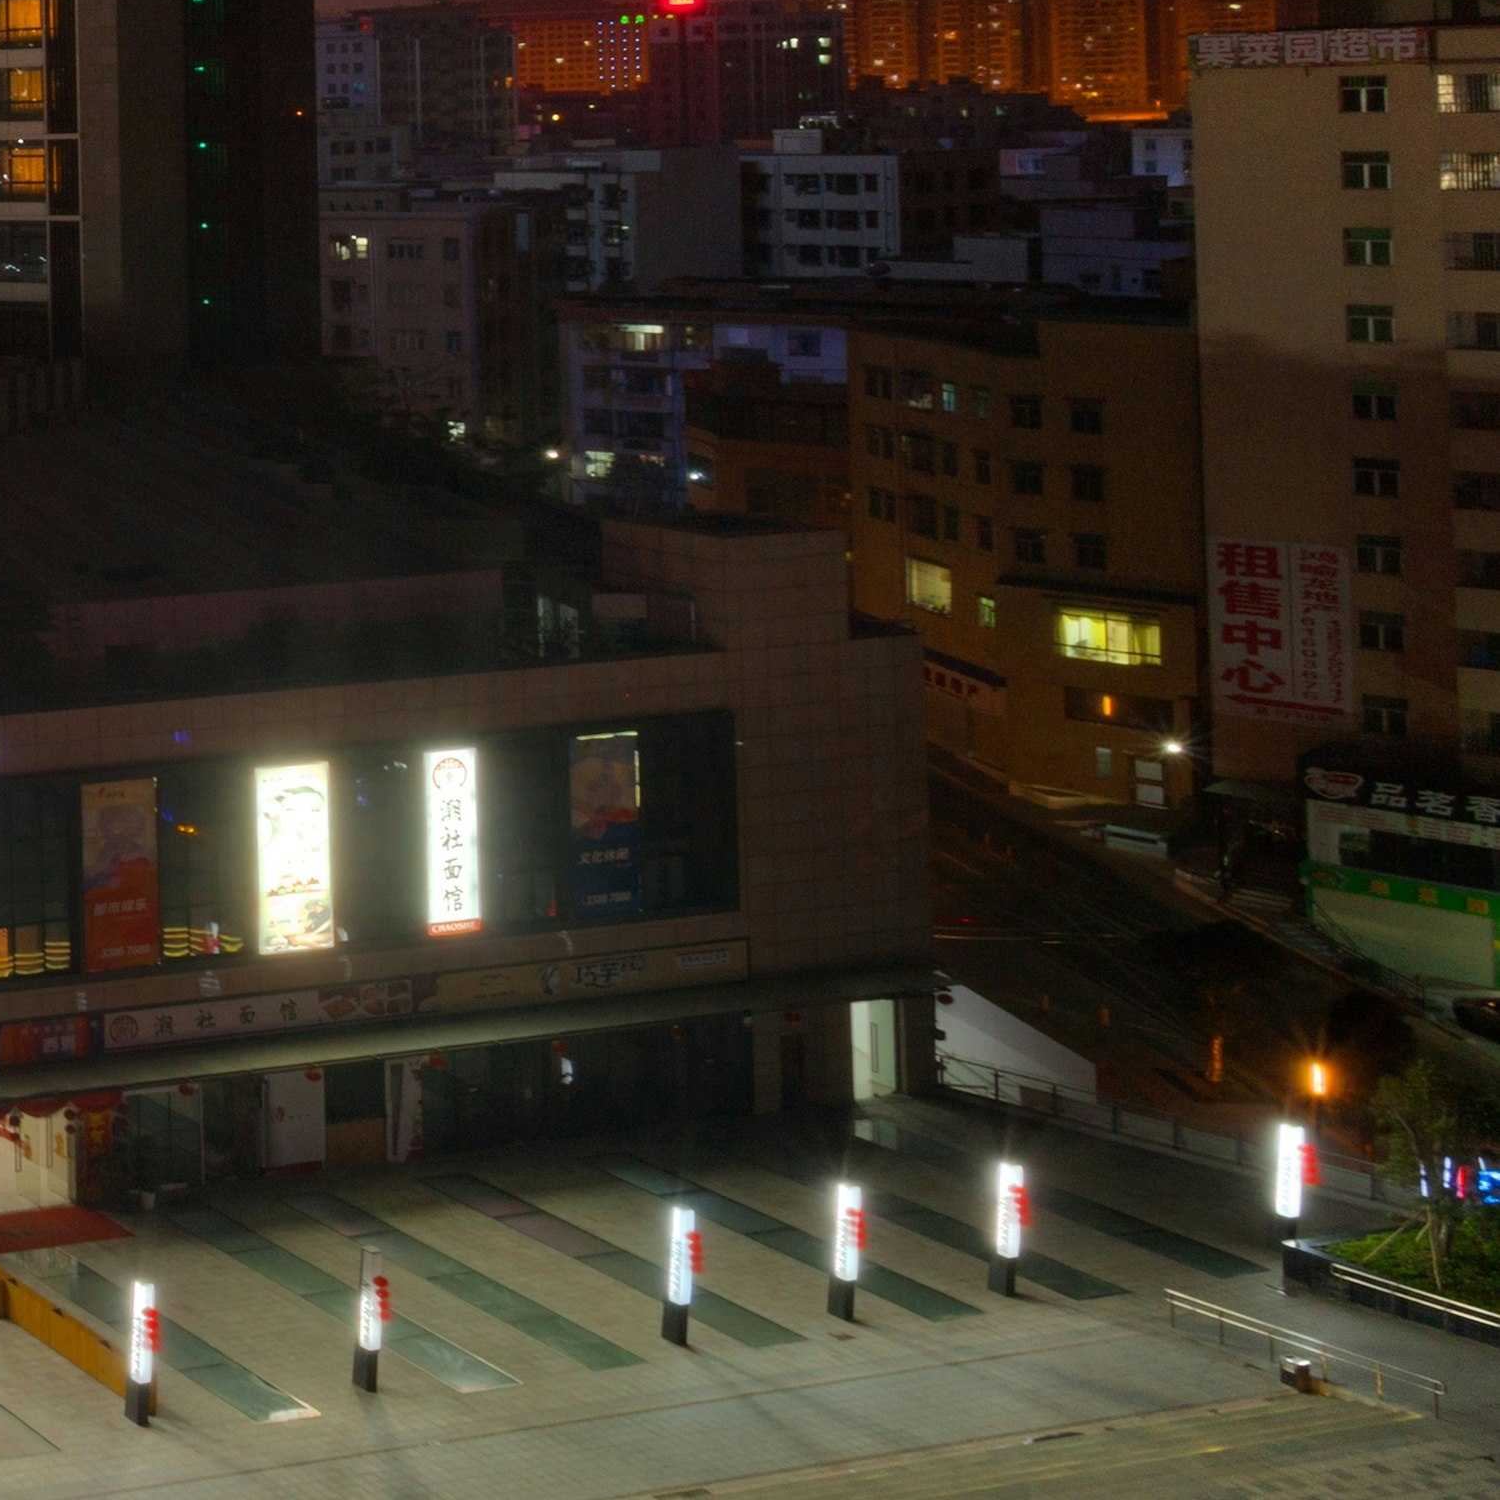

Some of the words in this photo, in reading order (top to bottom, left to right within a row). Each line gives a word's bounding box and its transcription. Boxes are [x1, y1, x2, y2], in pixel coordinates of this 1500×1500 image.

[1196, 26, 1418, 66] 果菜园超市
[1217, 542, 1286, 694] 租售中心
